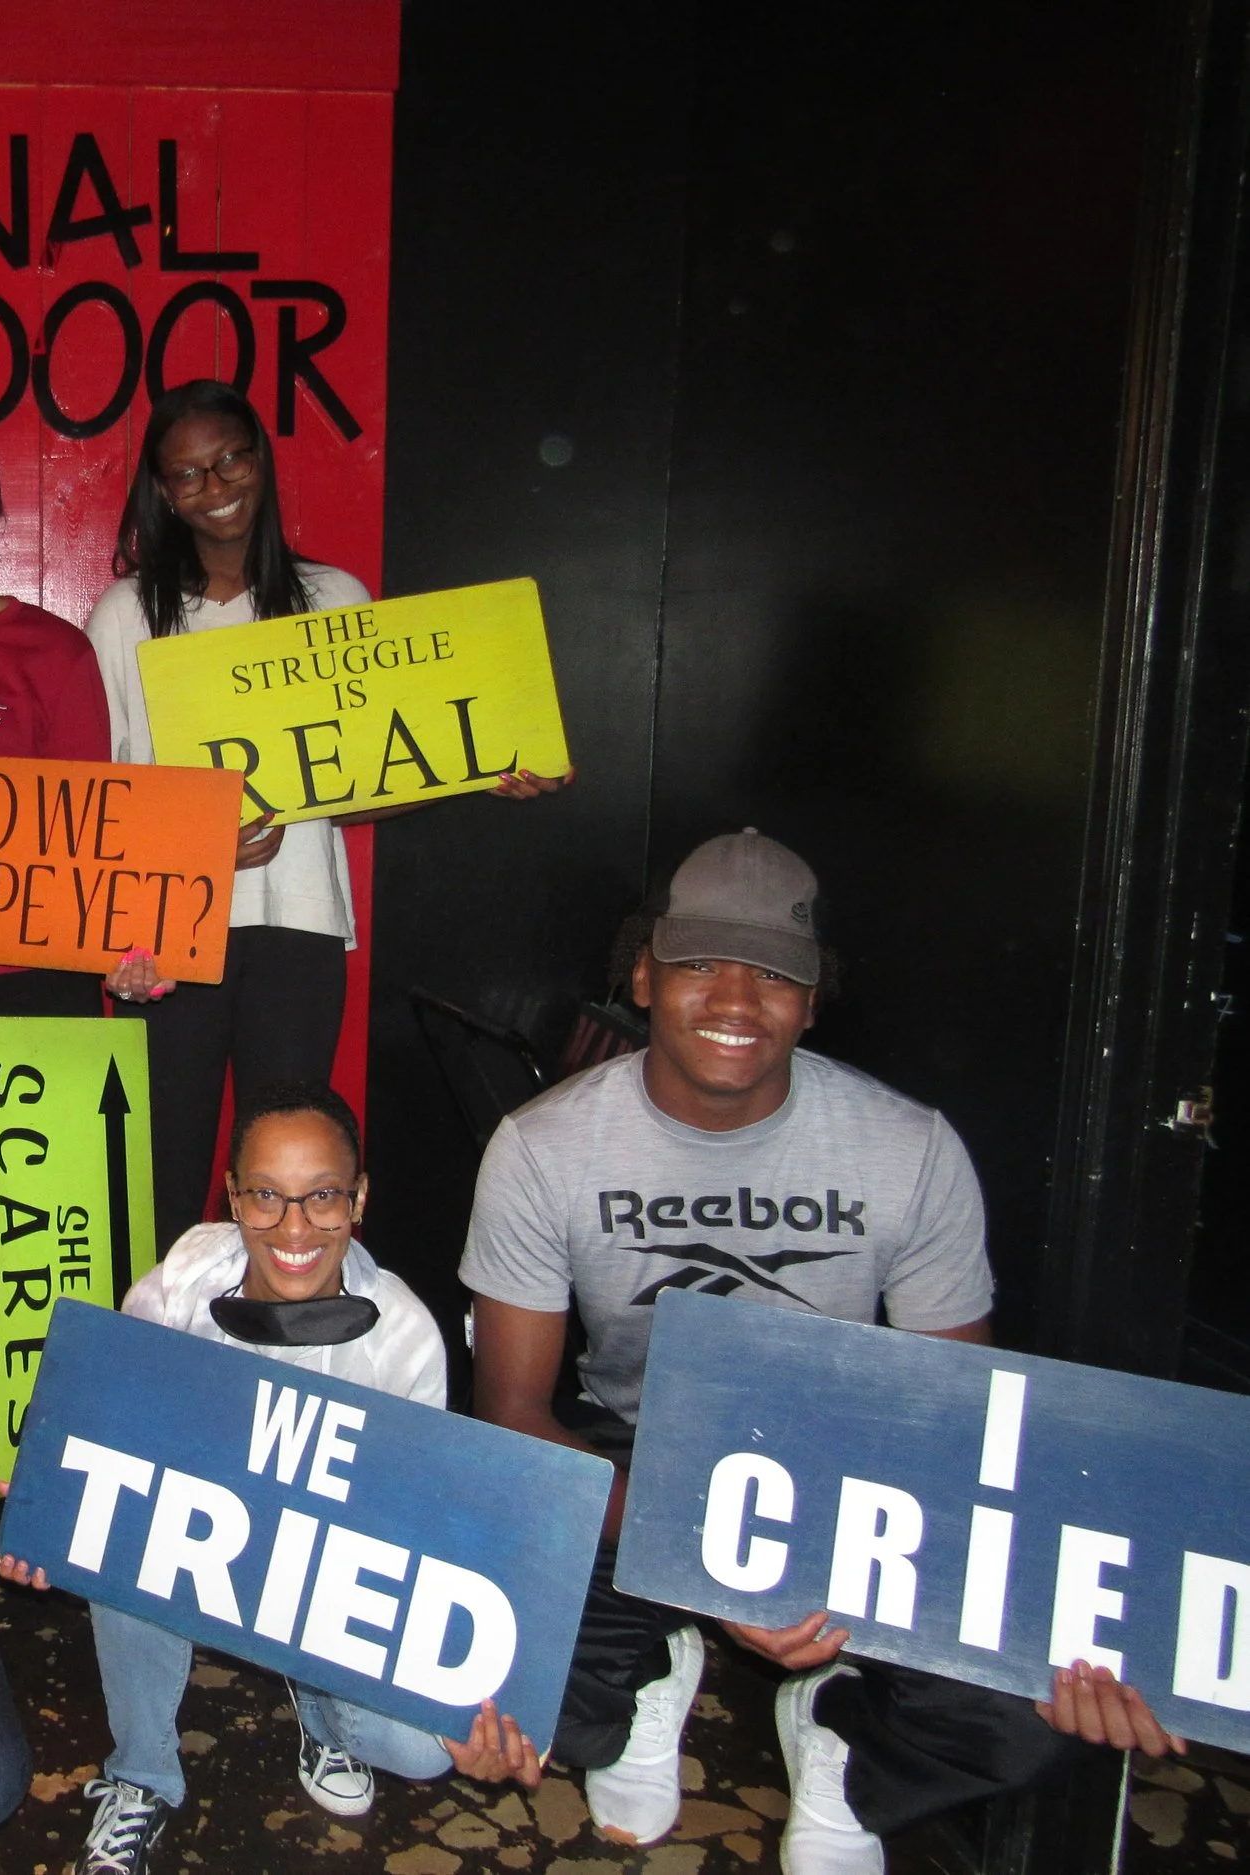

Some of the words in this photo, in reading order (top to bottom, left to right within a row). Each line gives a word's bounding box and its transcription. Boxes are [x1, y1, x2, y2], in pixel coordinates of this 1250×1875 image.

[231, 631, 455, 695] STRUGGLE
[295, 609, 379, 648] THE
[333, 679, 368, 711] IS
[198, 696, 519, 819] REAL
[37, 775, 131, 861] WE
[73, 867, 215, 959] YET?
[57, 1205, 92, 1292] SHE
[598, 1187, 865, 1239] Reebok
[247, 1378, 368, 1503] WE
[978, 1368, 1027, 1492] I
[60, 1435, 518, 1707] TRIED
[700, 1452, 1250, 1712] CRIED
